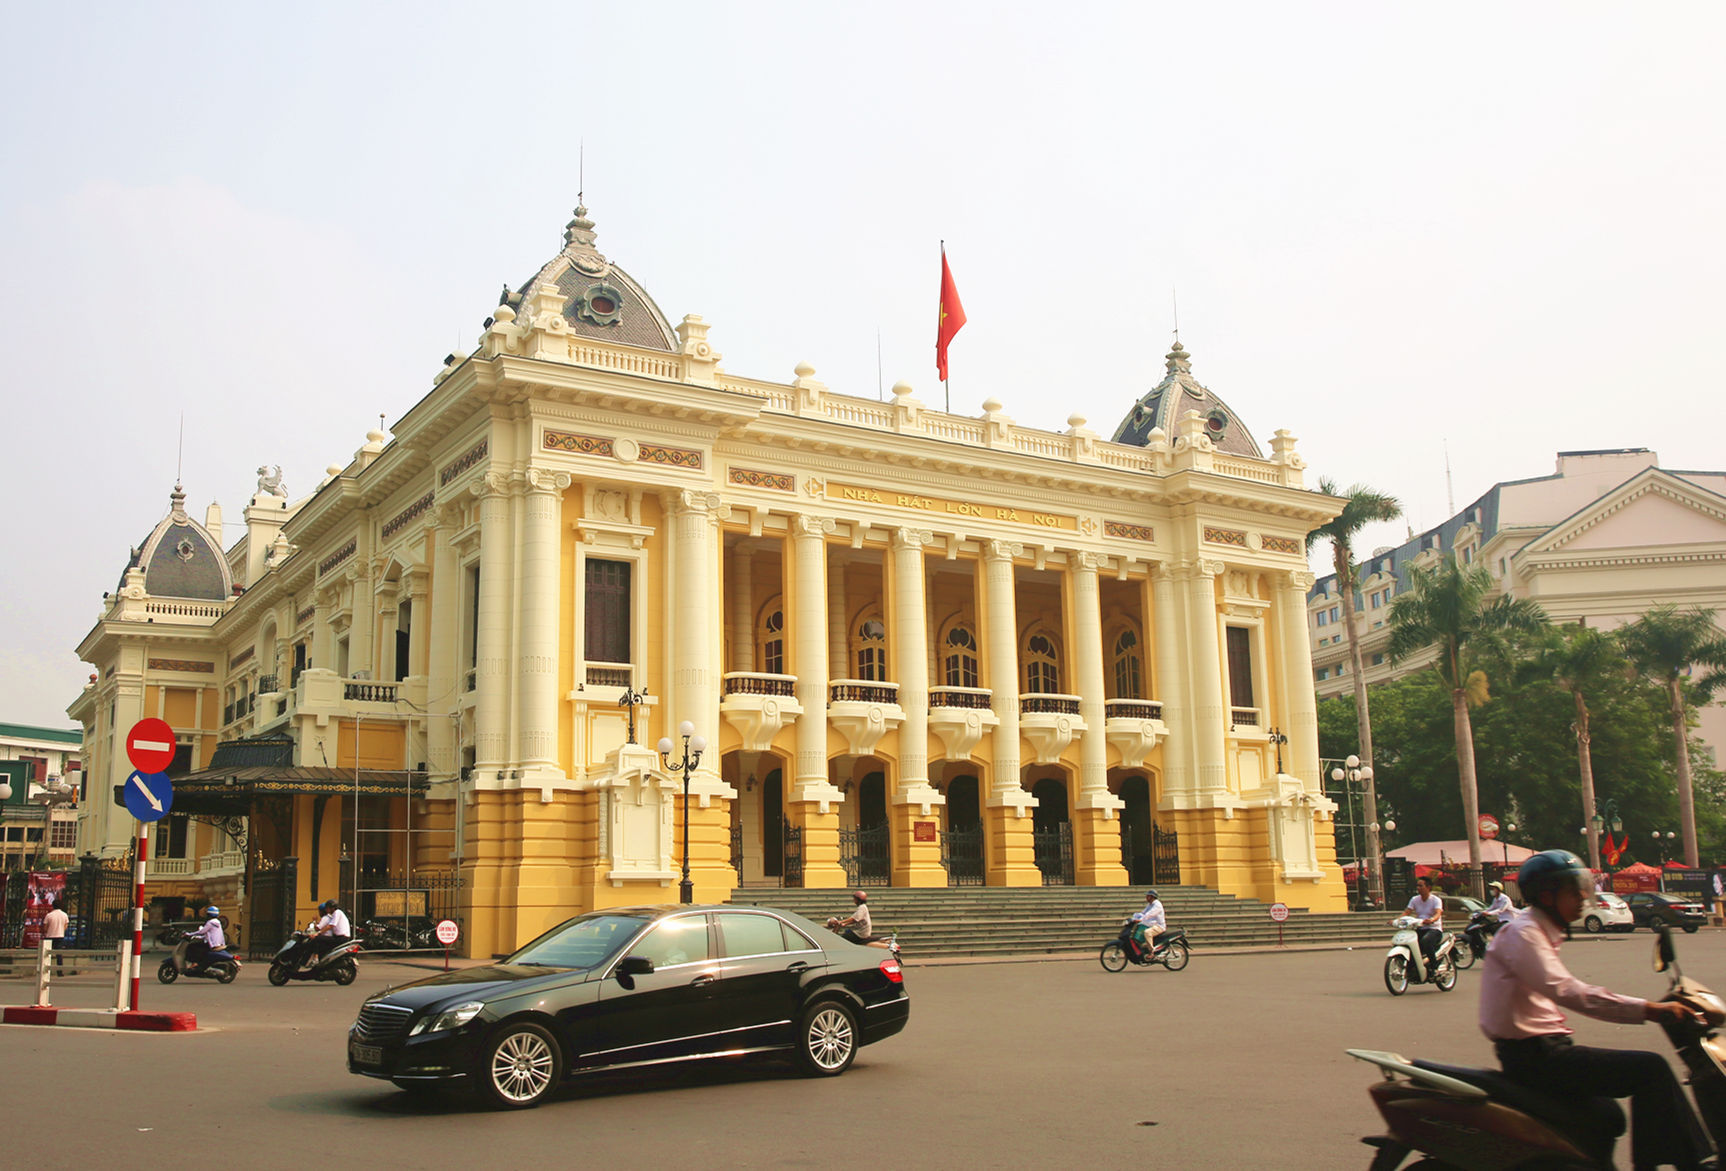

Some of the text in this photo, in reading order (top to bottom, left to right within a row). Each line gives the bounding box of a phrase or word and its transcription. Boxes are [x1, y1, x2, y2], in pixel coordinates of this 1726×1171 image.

[843, 487, 1063, 529] NHÀ HÁT LỚN HÀ NỘI
